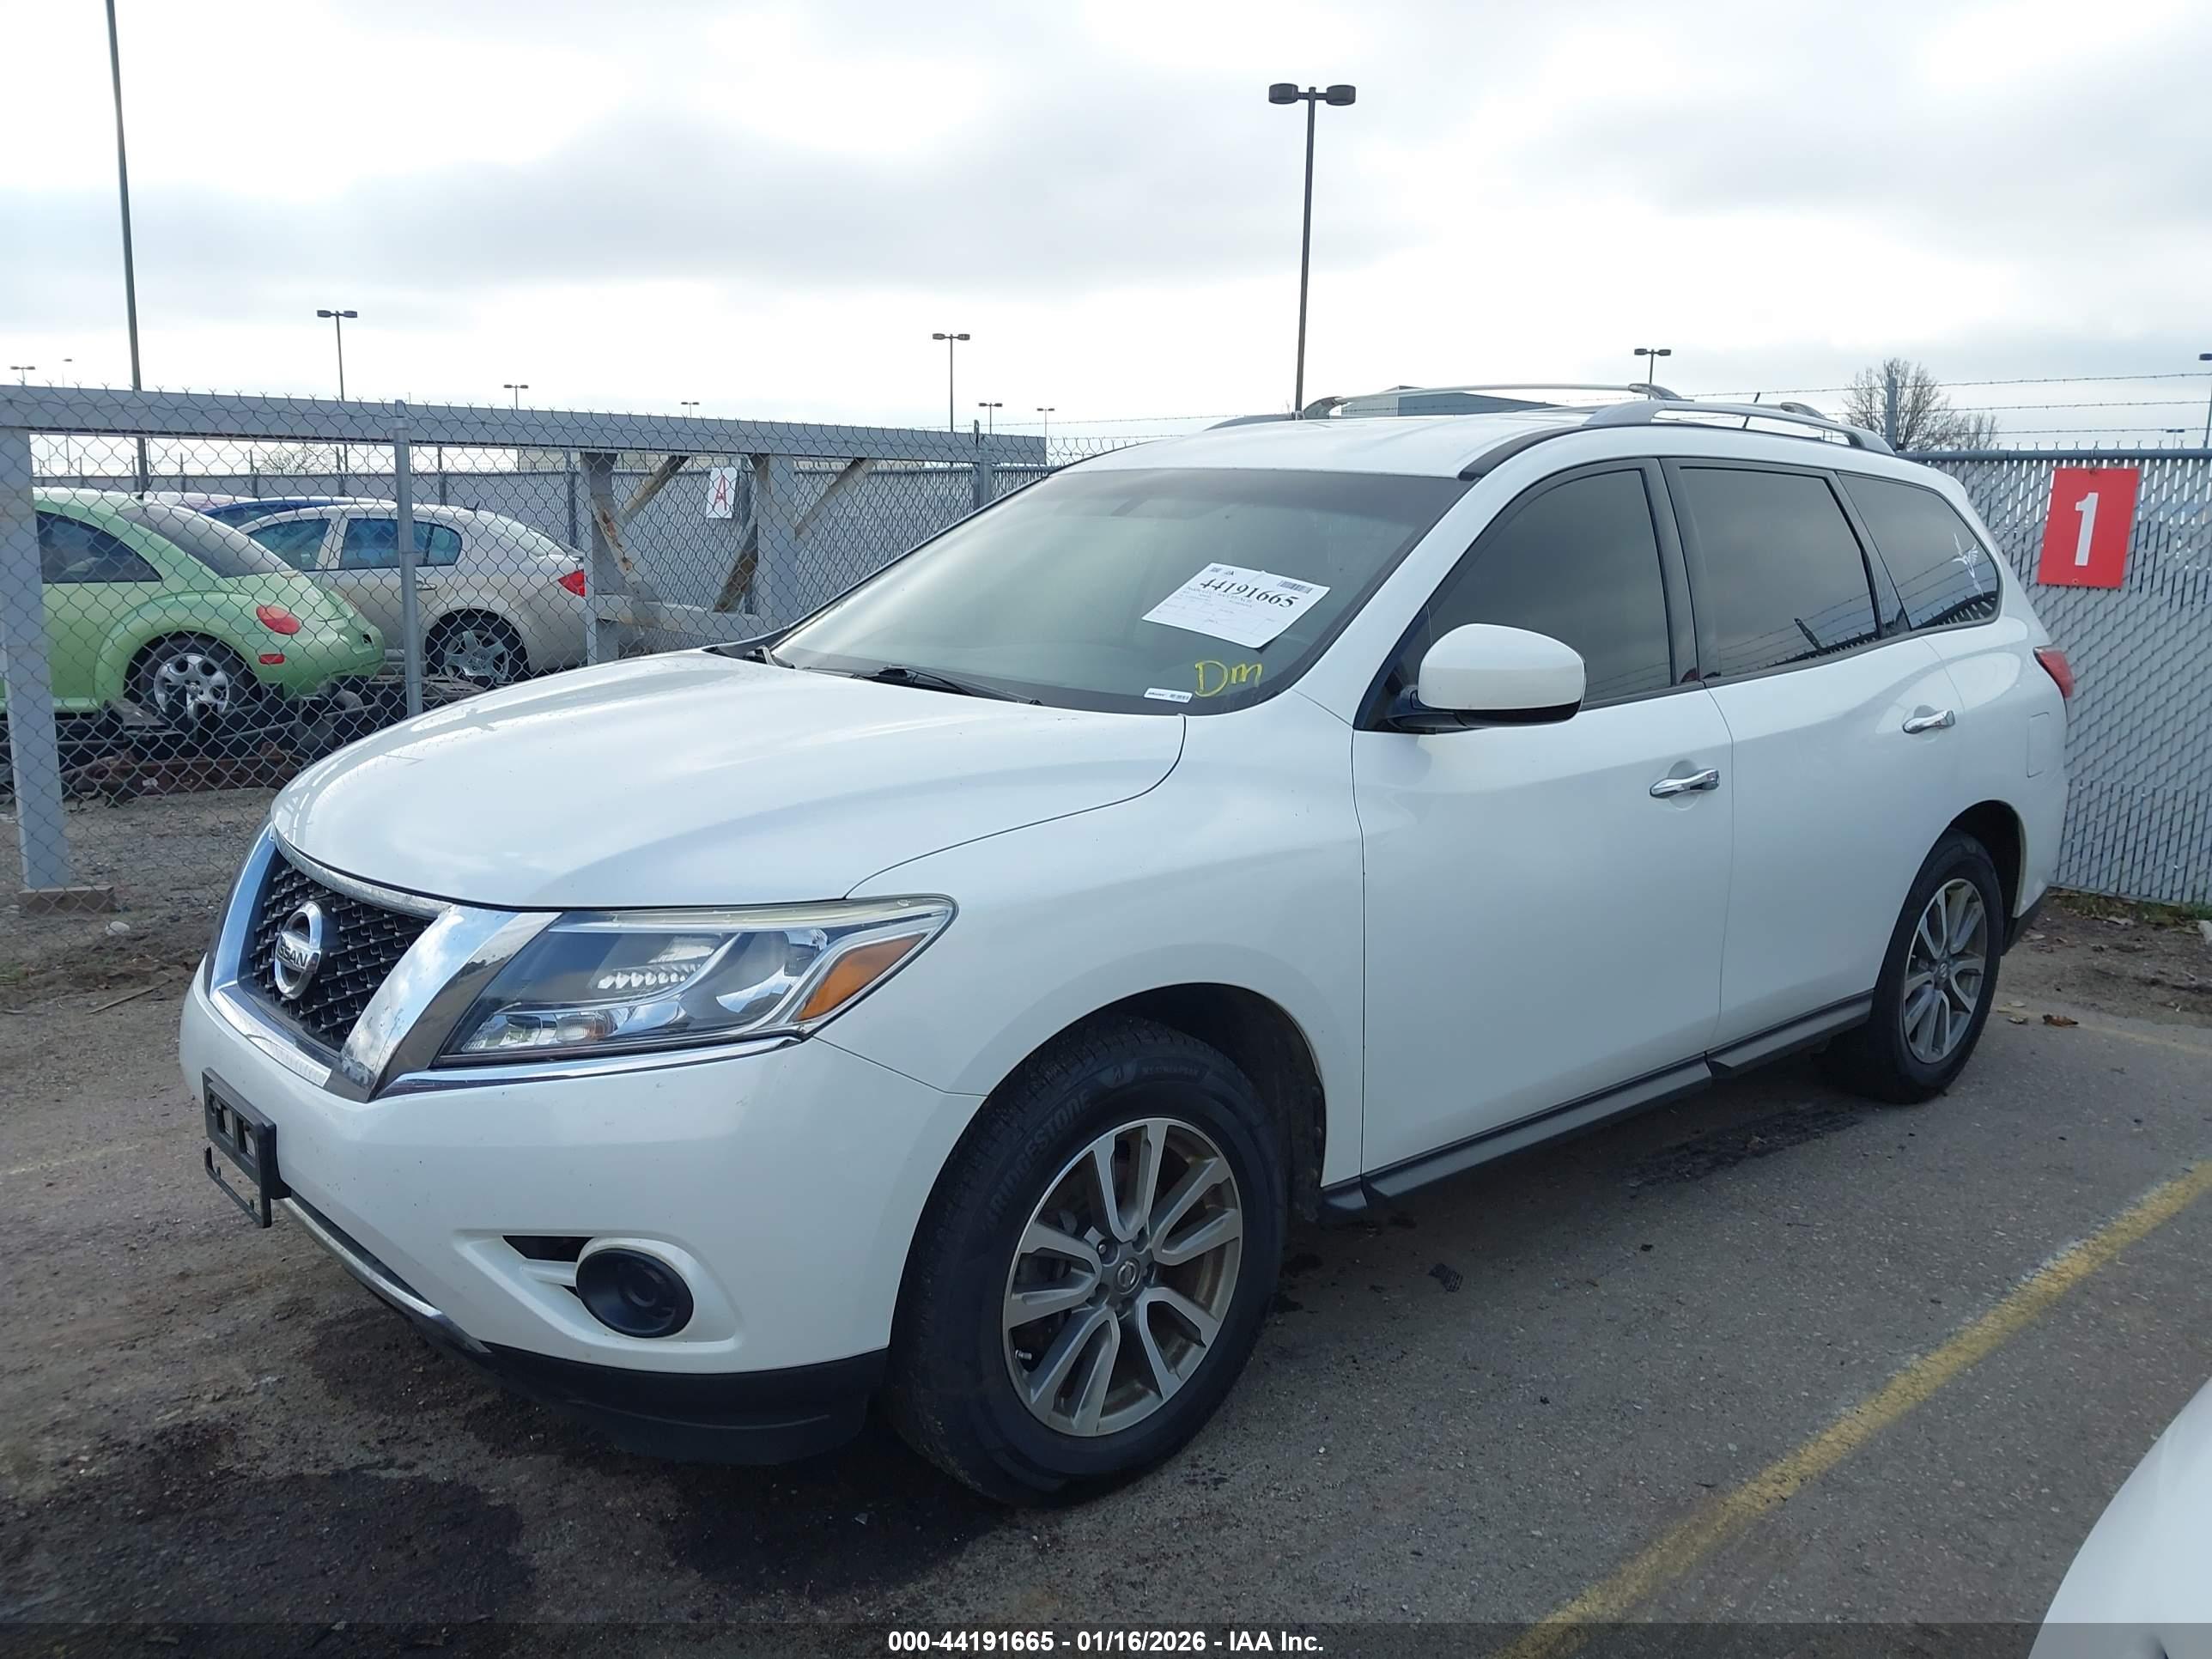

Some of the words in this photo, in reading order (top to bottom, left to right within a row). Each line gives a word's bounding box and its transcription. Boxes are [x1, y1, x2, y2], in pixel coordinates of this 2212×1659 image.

[713, 475, 727, 511] A
[2075, 491, 2100, 567] 1
[1200, 578, 1299, 609] 44191665
